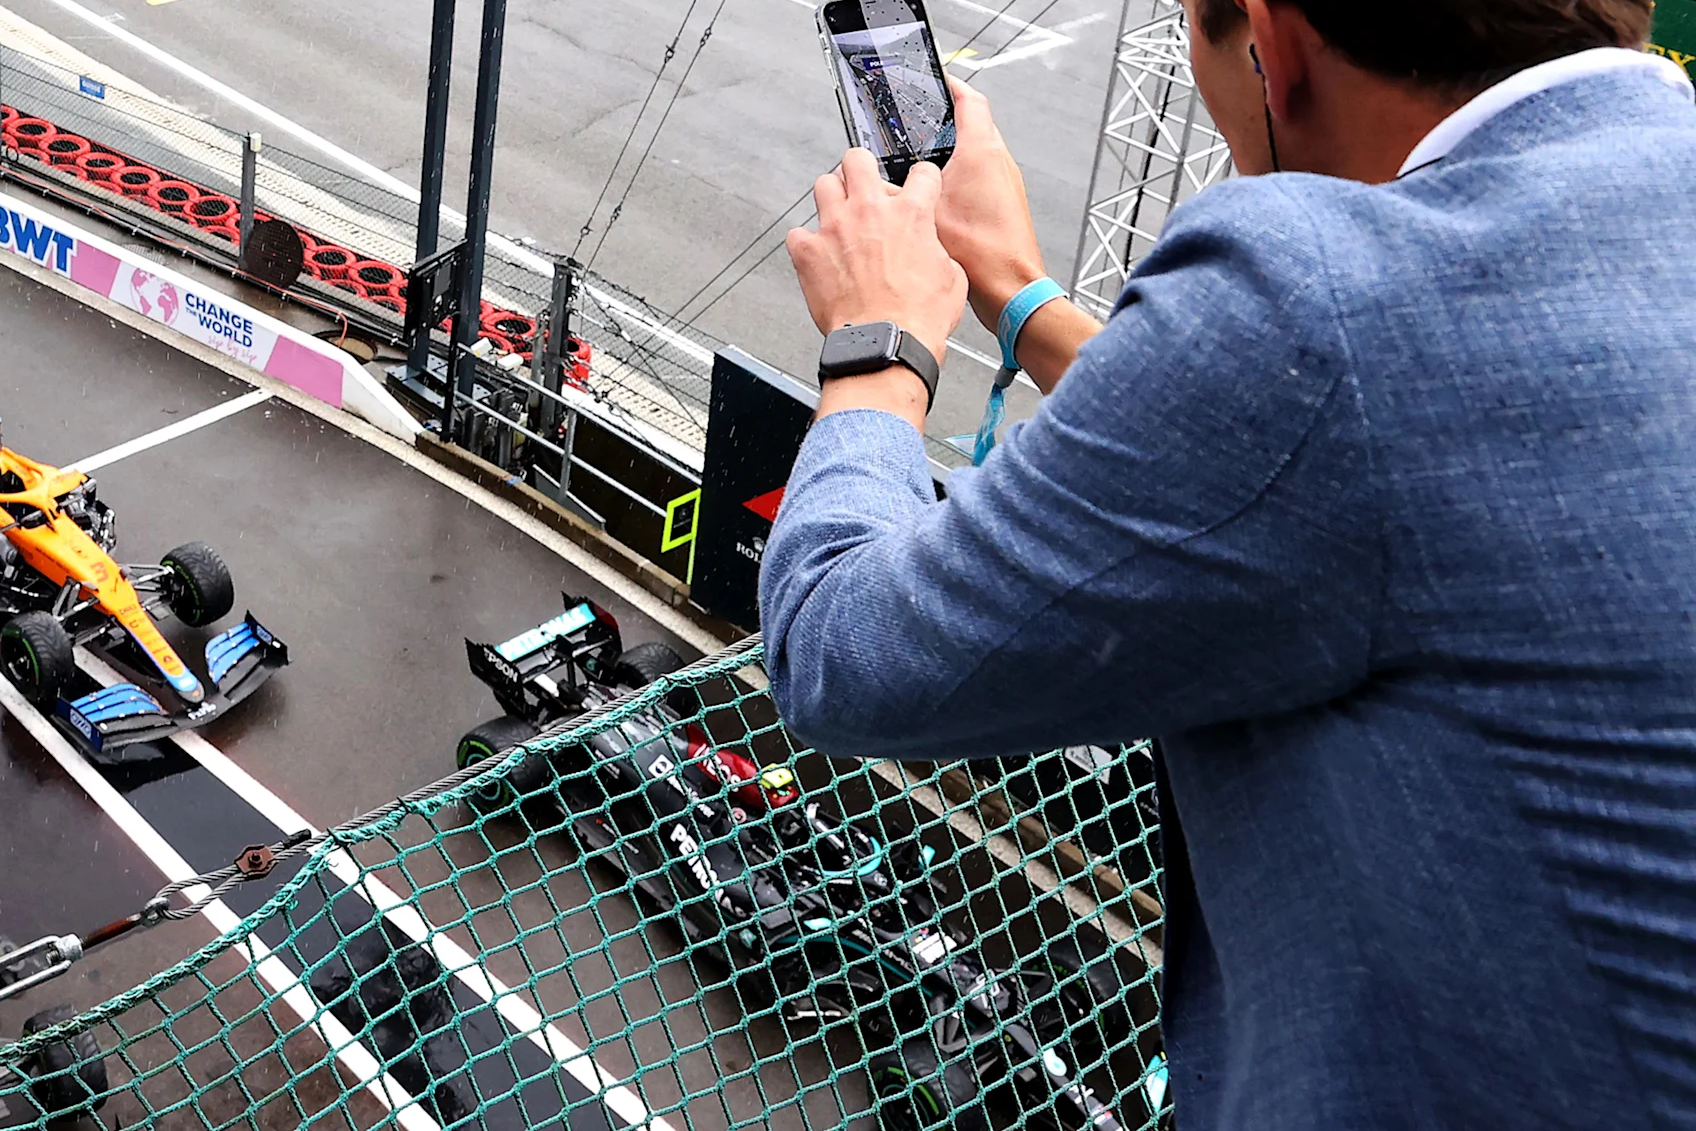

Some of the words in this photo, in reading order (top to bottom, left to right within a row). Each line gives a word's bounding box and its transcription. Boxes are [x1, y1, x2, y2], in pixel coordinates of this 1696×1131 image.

[185, 293, 253, 335] CHANGE
[198, 313, 252, 347] WORLD
[736, 541, 762, 564] ROL
[483, 646, 518, 683] EPSON
